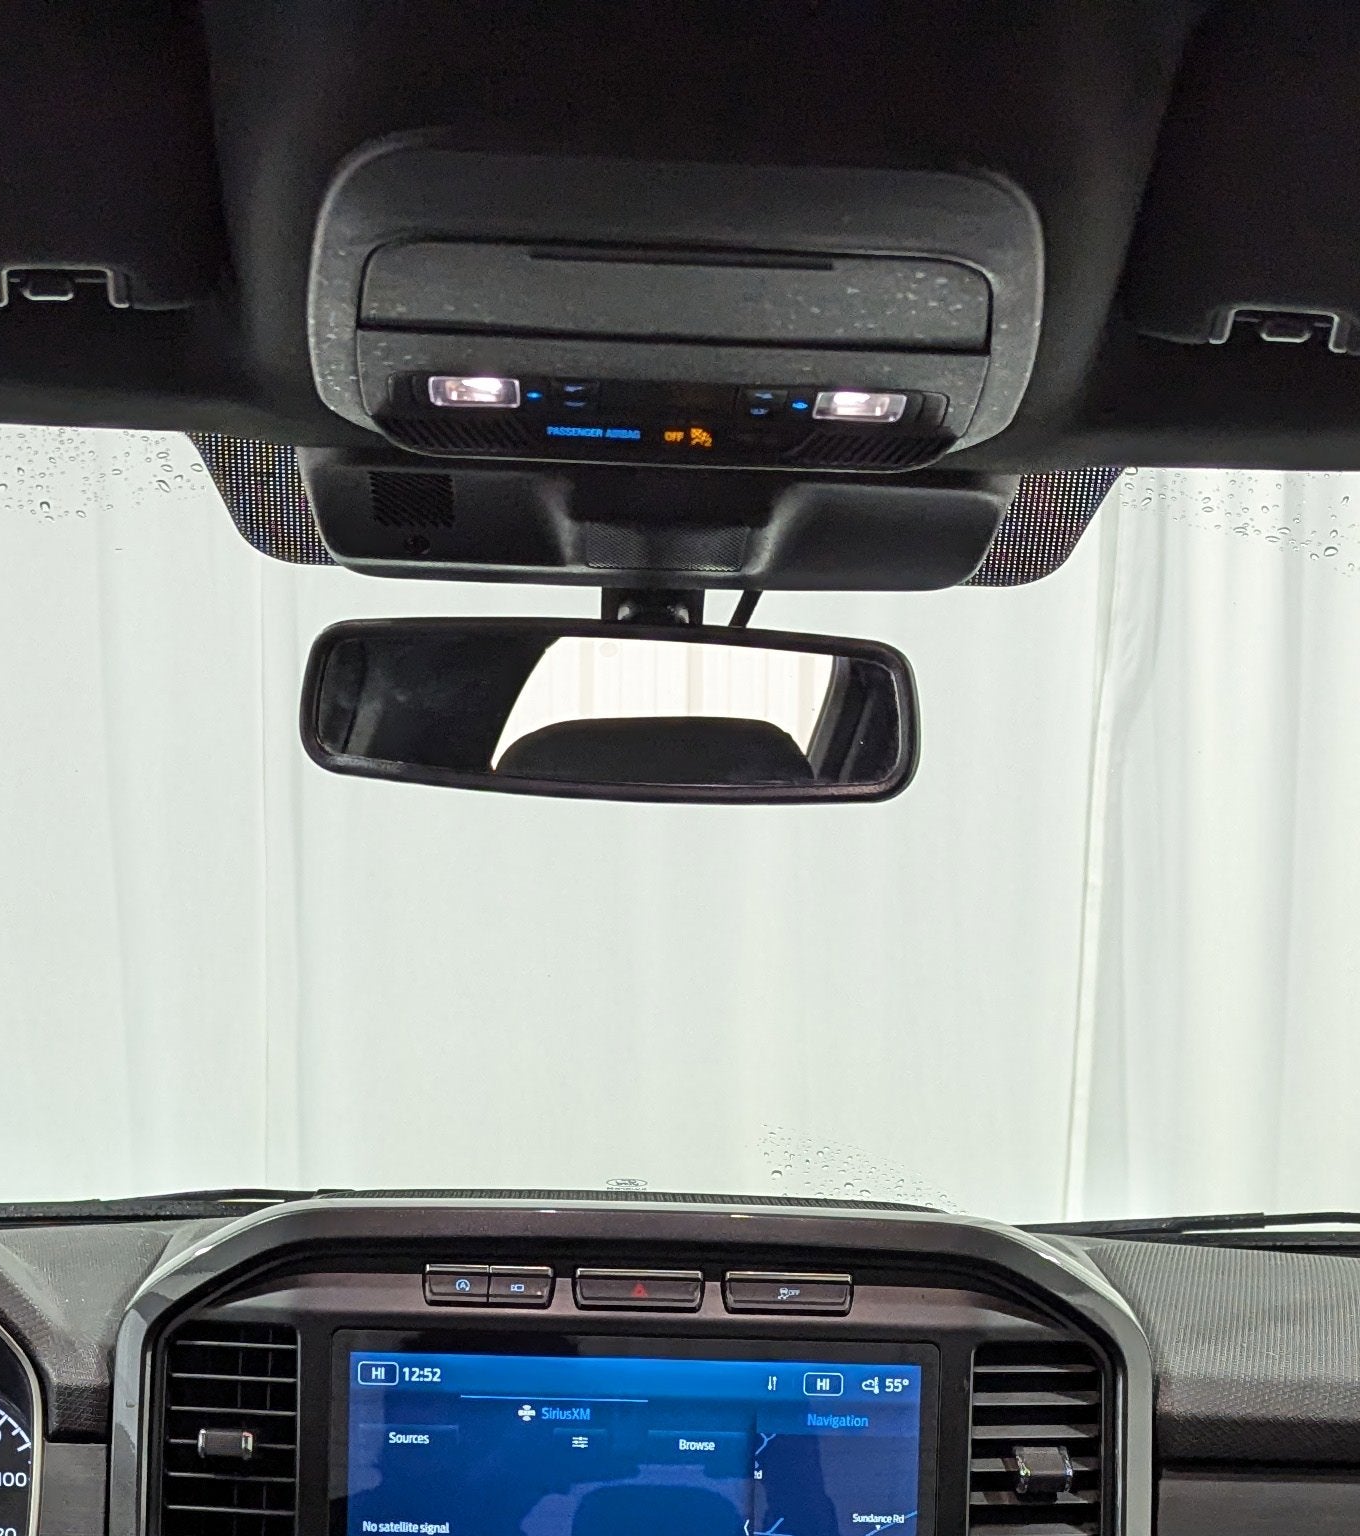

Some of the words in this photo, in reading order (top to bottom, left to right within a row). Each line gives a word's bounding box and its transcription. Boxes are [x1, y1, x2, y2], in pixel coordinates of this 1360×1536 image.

[546, 426, 603, 438] PASSENGER
[605, 428, 641, 439] AIRBAG
[663, 431, 684, 442] OFF
[371, 1367, 386, 1380] HI
[402, 1367, 441, 1382] 12:52
[816, 1378, 830, 1391] HI
[884, 1378, 909, 1393] 55°
[541, 1407, 591, 1420] SiriusXM
[806, 1413, 869, 1428] Navigation
[388, 1431, 430, 1444] Sources
[678, 1439, 716, 1451] Browse
[852, 1512, 892, 1523] Sundance
[892, 1514, 905, 1524] Rd
[362, 1520, 378, 1533] No
[378, 1521, 419, 1534] satellite
[419, 1522, 450, 1535] signal
